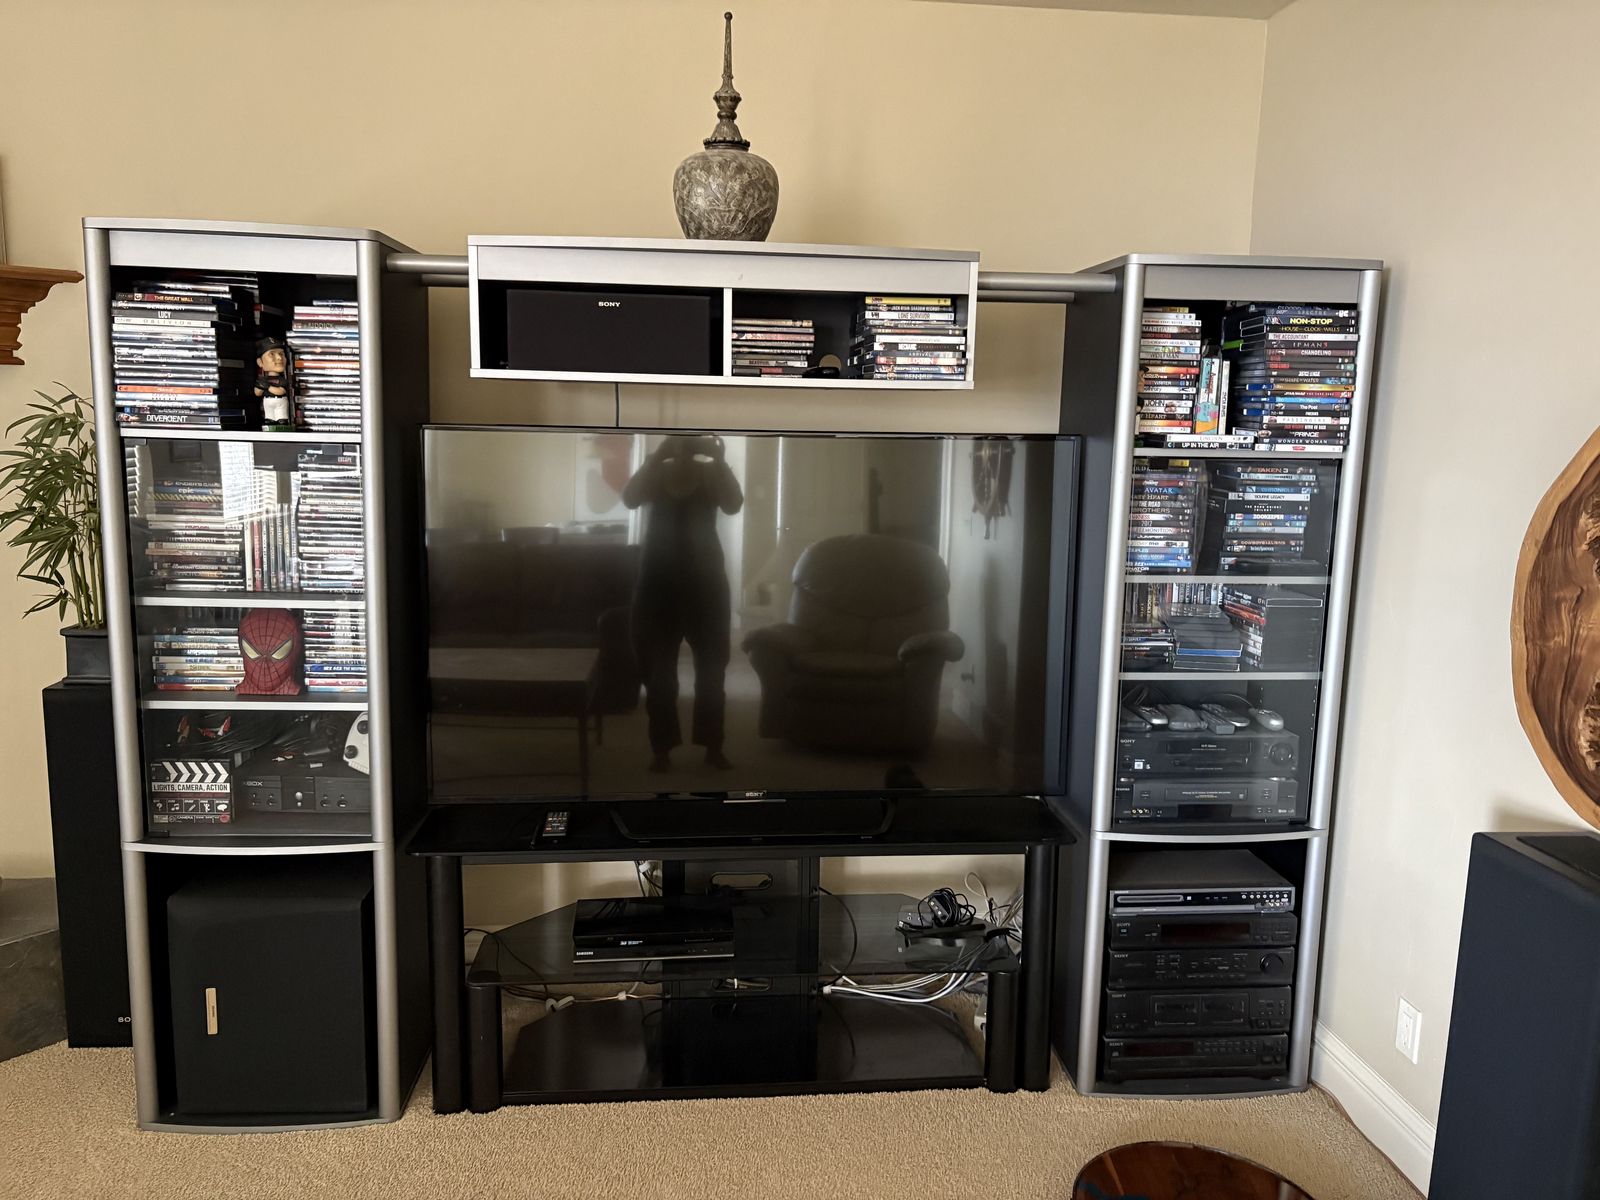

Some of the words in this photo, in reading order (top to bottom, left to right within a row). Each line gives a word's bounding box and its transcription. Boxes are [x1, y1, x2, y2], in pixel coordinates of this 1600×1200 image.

[157, 311, 171, 319] LUCY
[146, 414, 188, 423] DIVERGENT
[177, 784, 206, 792] CAMERA,
